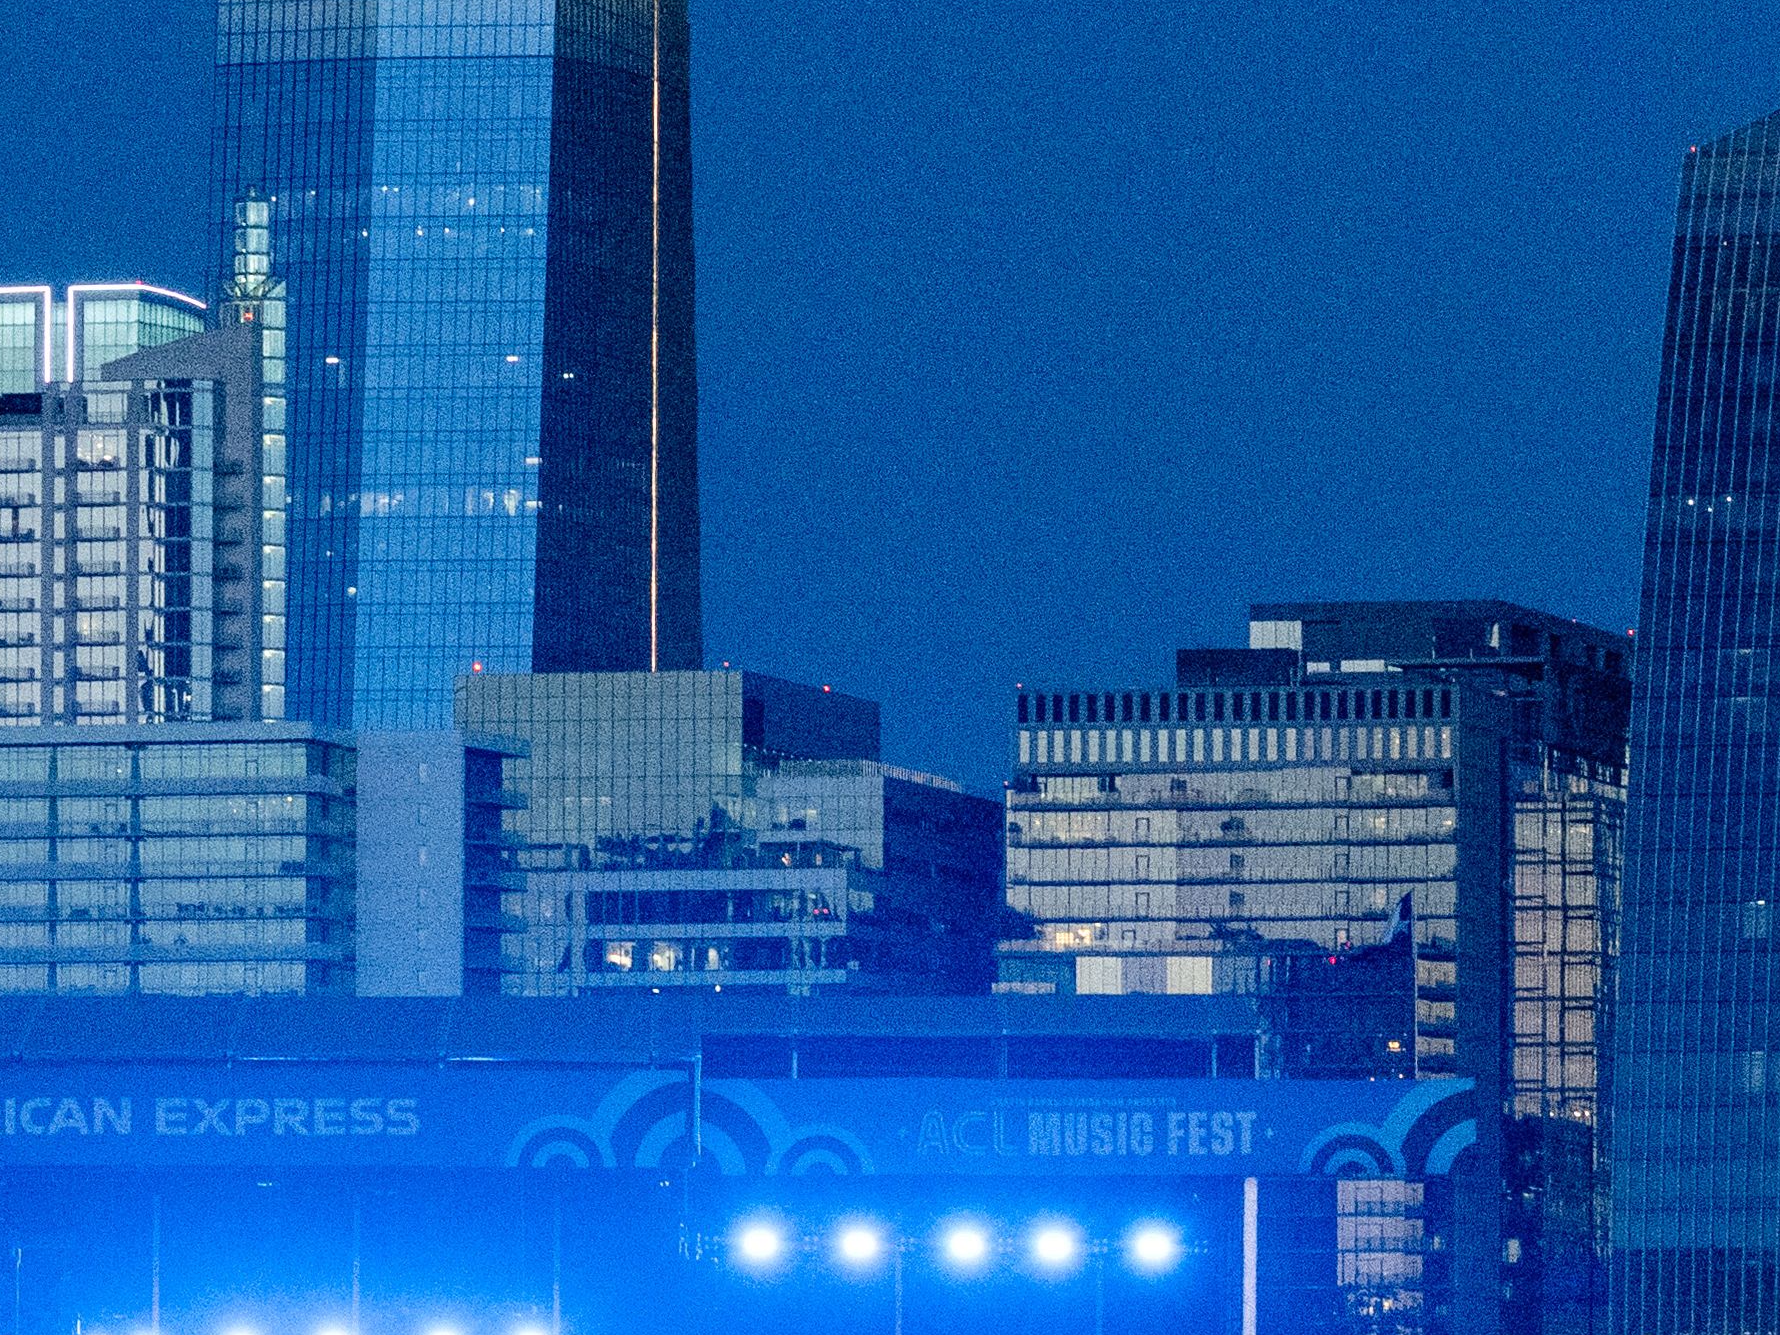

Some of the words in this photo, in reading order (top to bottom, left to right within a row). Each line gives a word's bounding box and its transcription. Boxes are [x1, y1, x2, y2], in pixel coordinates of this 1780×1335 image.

[154, 1096, 420, 1136] EXPRESS
[915, 1110, 1017, 1156] ACL
[1028, 1111, 1154, 1156] MUSIC
[1166, 1111, 1257, 1155] FEST
